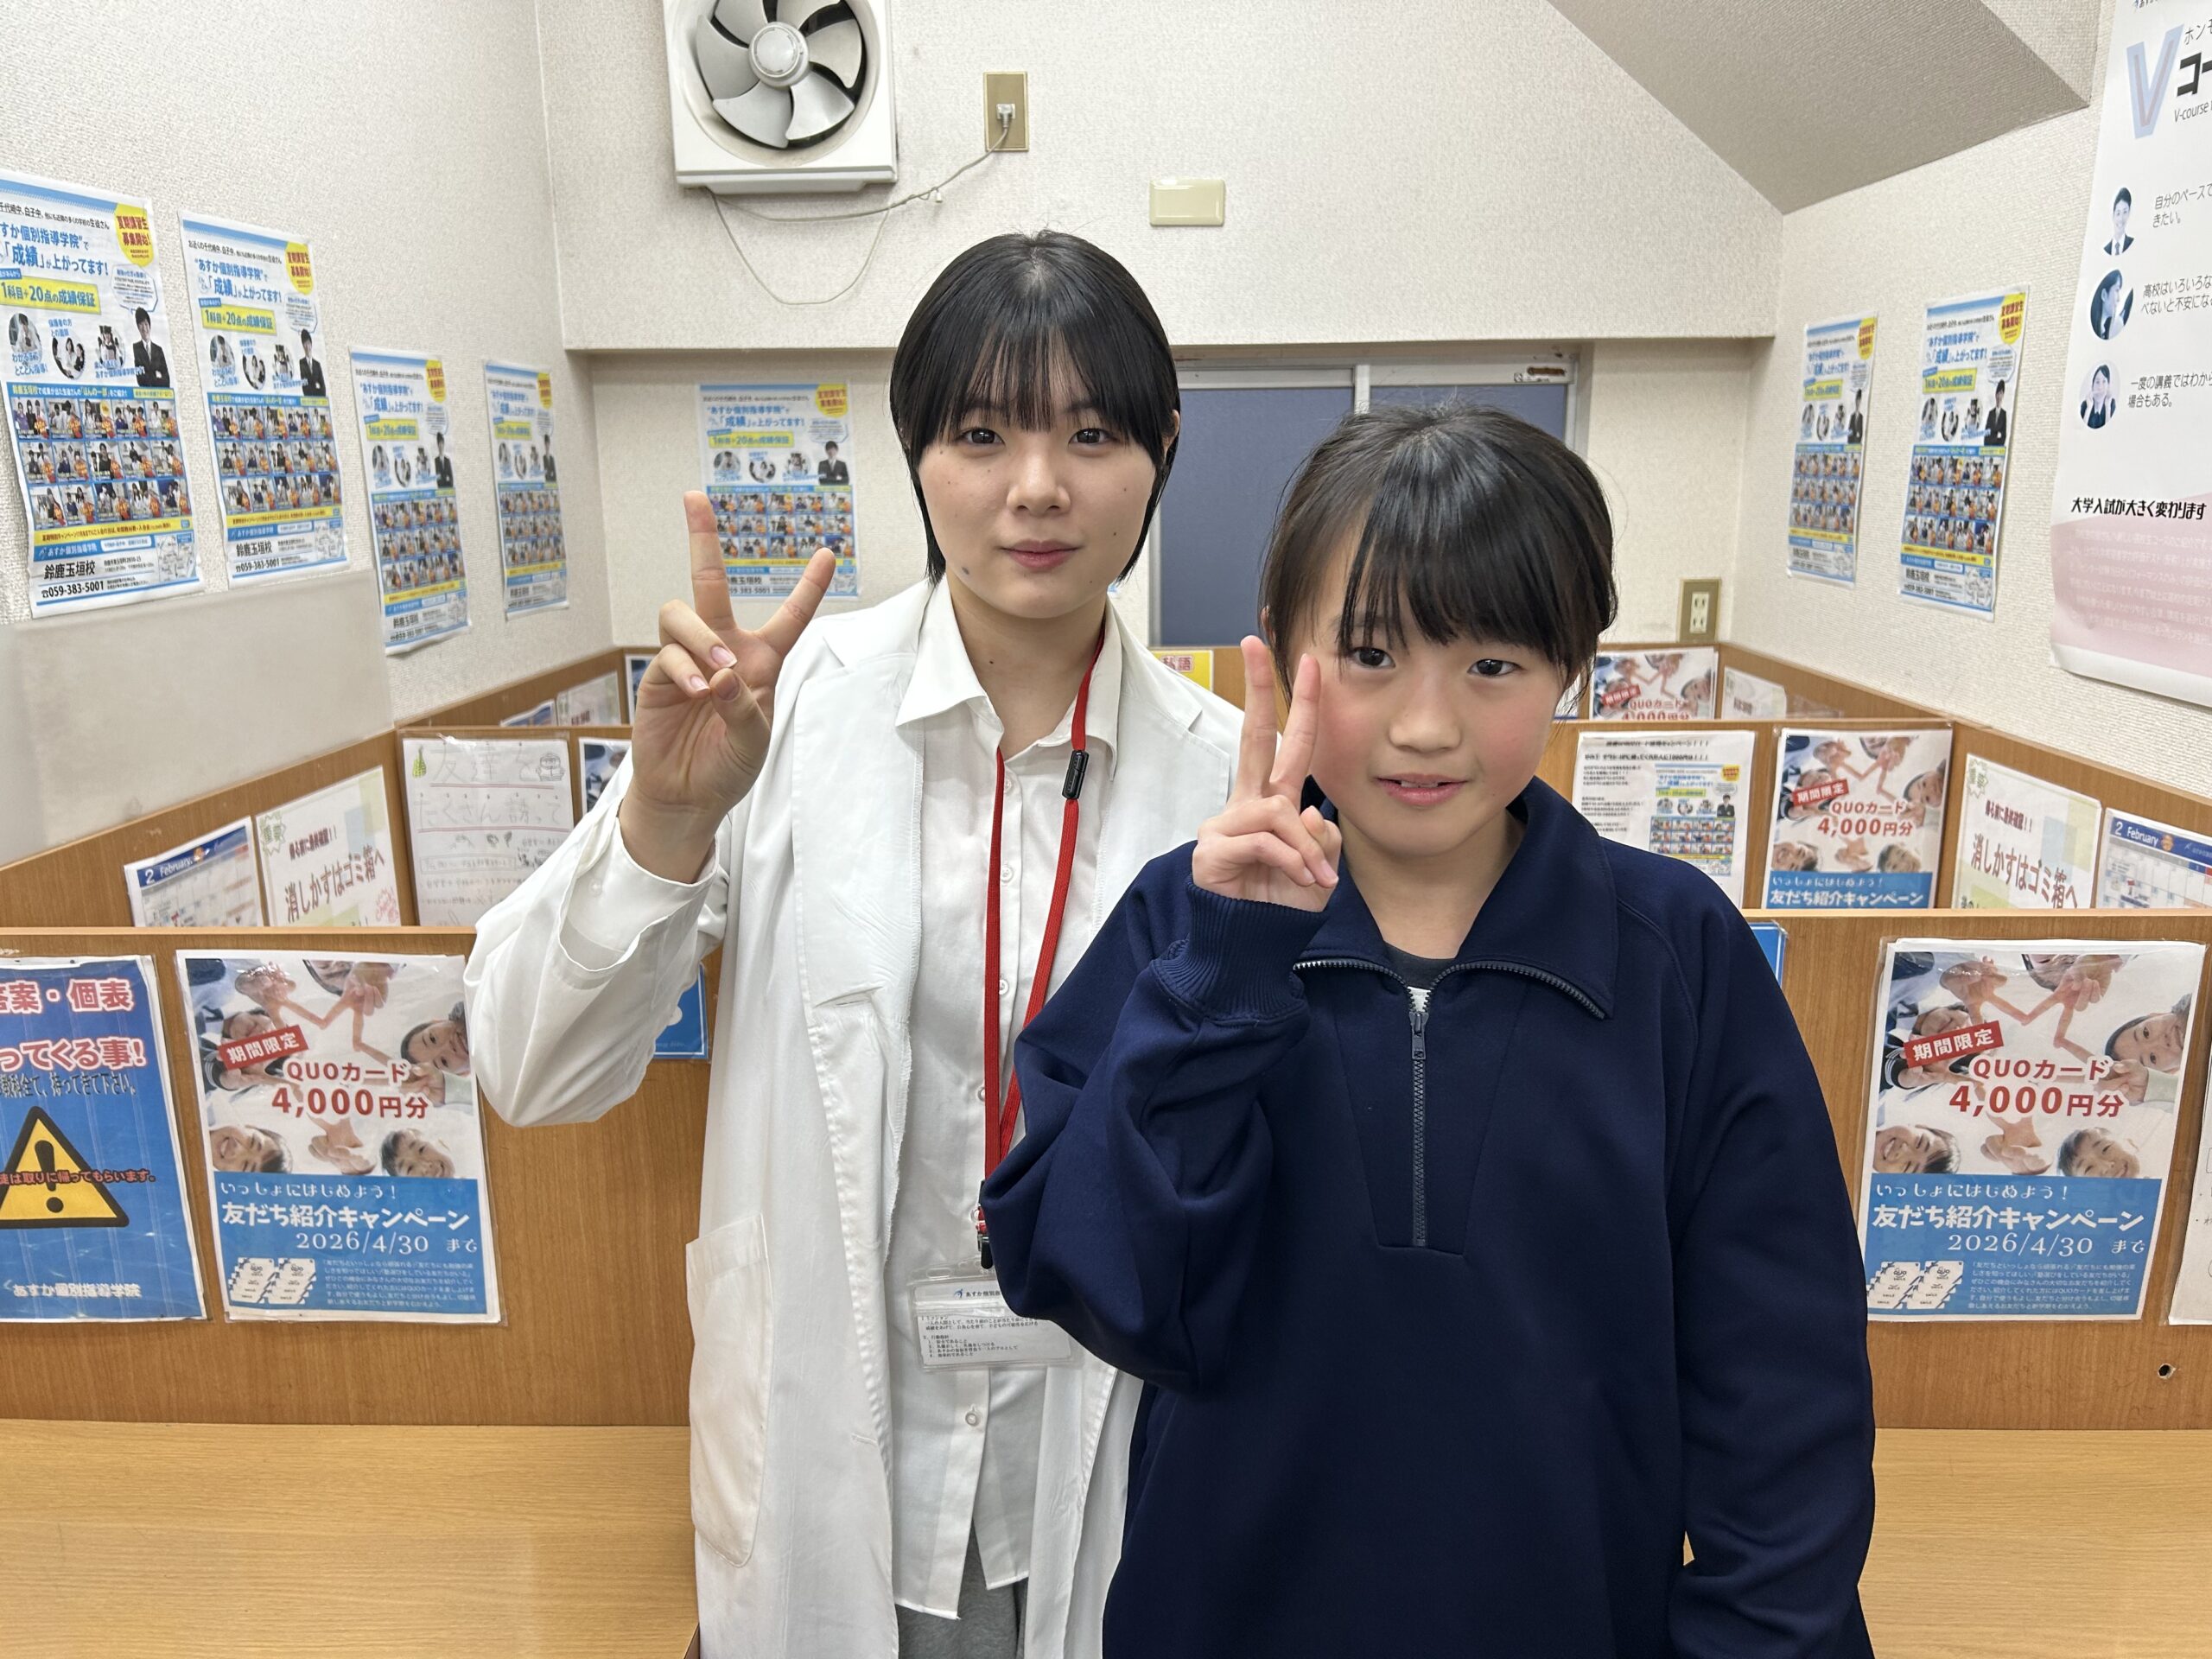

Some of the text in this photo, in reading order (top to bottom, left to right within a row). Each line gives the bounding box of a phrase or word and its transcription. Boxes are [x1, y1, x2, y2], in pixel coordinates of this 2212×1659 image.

[2174, 101, 2209, 123] V-course
[2071, 497, 2207, 520] 大学入試が大きく変わります
[44, 560, 96, 580] 鈴鹿玉垣校
[48, 581, 105, 598] 059-383-5001
[1797, 782, 1845, 804] 期間限定
[1832, 802, 1906, 816] QUOカード
[1817, 817, 1913, 837] 4,000円分
[2114, 821, 2159, 847] 2 February
[145, 857, 191, 885] 2 February
[1971, 833, 2077, 908] 消しかすはゴミ箱へ
[285, 844, 385, 924] 消しかすはゴミ箱へ
[1770, 889, 1923, 906] 友だち紹介キャンペーン
[226, 1032, 300, 1064] 期間限定
[1912, 1028, 1994, 1061] 期間限定
[286, 1061, 410, 1084] QUOカード
[1974, 1058, 2113, 1081] QUOカード
[271, 1087, 429, 1120] 4,000円分
[1949, 1085, 2124, 1117] 4,000円分
[222, 1201, 470, 1230] 友だち紹介キャンペーン
[1872, 1205, 2145, 1231] 友だち紹介キャンペーン
[296, 1230, 478, 1255] 2026/4/30 まで
[1948, 1232, 2145, 1257] 2026/4/30 まで
[13, 1283, 142, 1298] あすか個別指導学院
